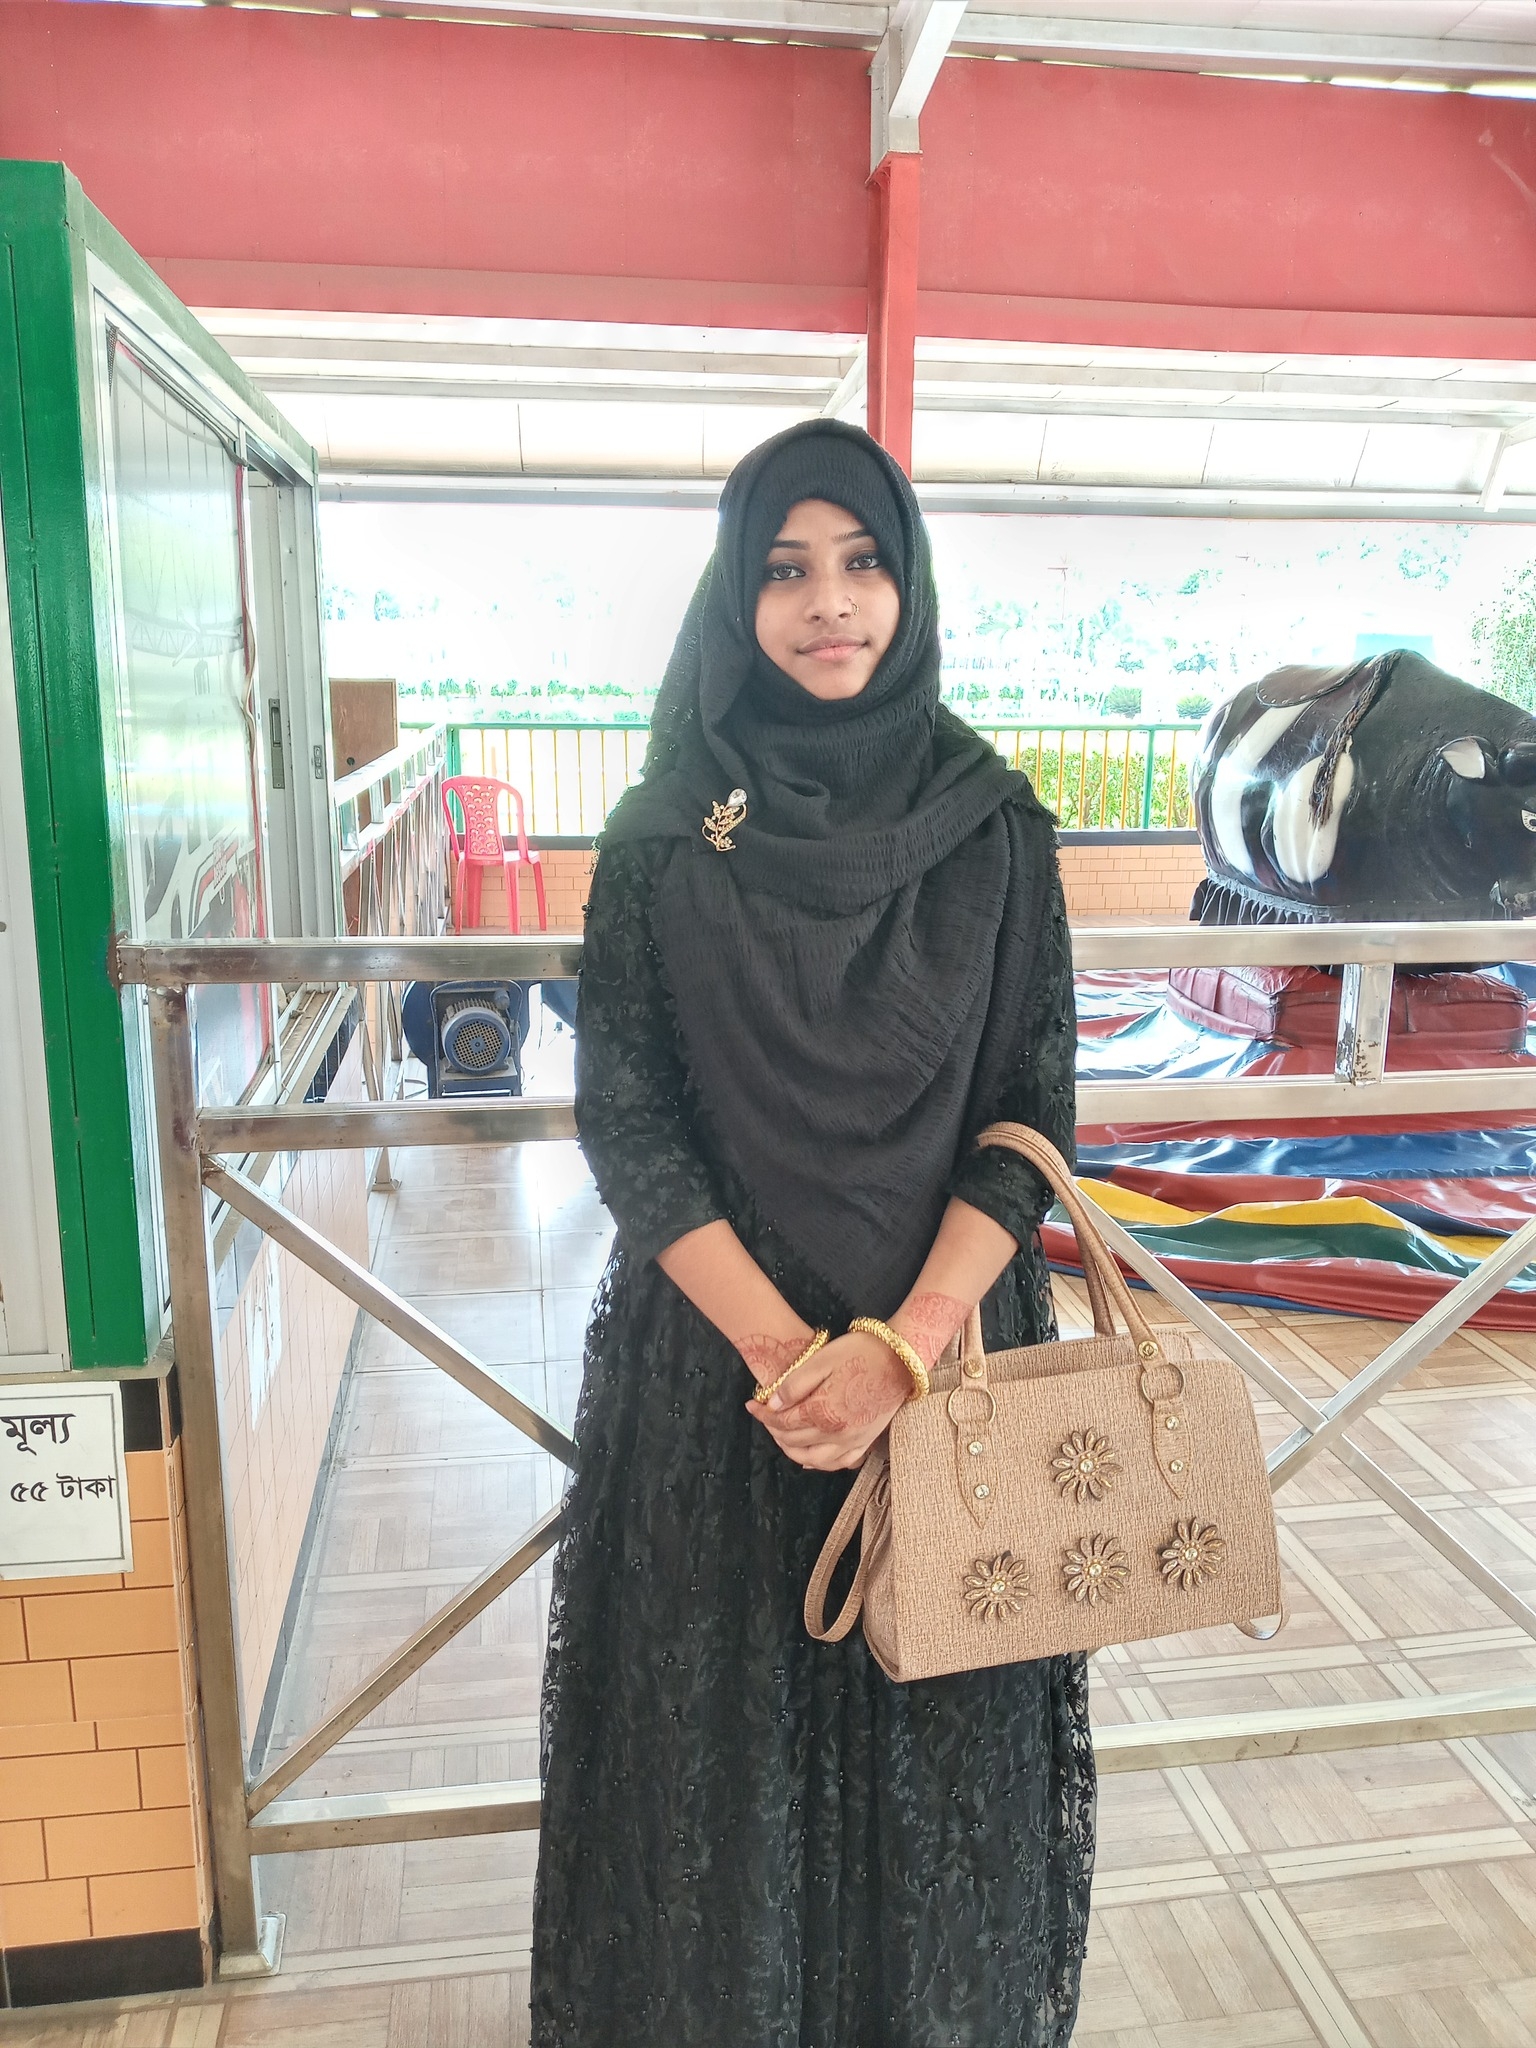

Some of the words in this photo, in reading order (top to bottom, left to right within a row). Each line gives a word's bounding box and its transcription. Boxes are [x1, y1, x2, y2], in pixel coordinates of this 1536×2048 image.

[0, 1414, 75, 1456] মূল্য
[10, 1482, 49, 1502] ৫৫
[56, 1473, 116, 1500] টাকা
